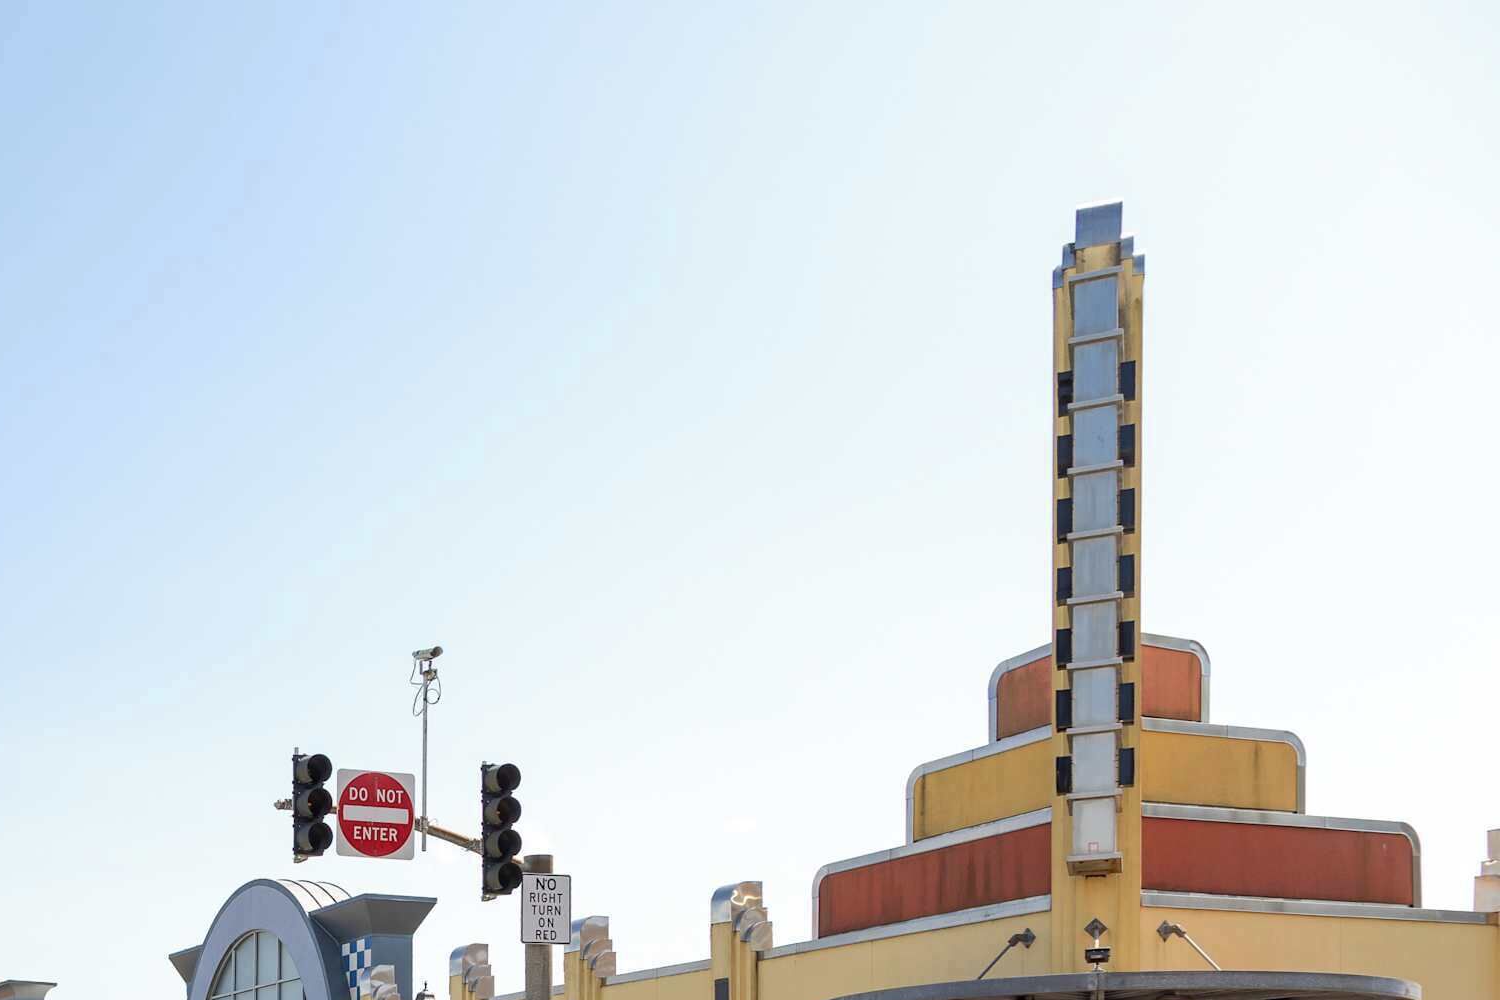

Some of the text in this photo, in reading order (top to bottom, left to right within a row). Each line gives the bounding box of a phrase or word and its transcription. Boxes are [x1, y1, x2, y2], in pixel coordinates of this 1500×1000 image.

[349, 786, 404, 804] DO NOT
[353, 825, 398, 842] ENTER
[536, 877, 556, 891] NO
[529, 892, 563, 904] RIGHT
[531, 904, 561, 916] TURN
[538, 917, 554, 928] ON
[535, 929, 557, 941] RED
